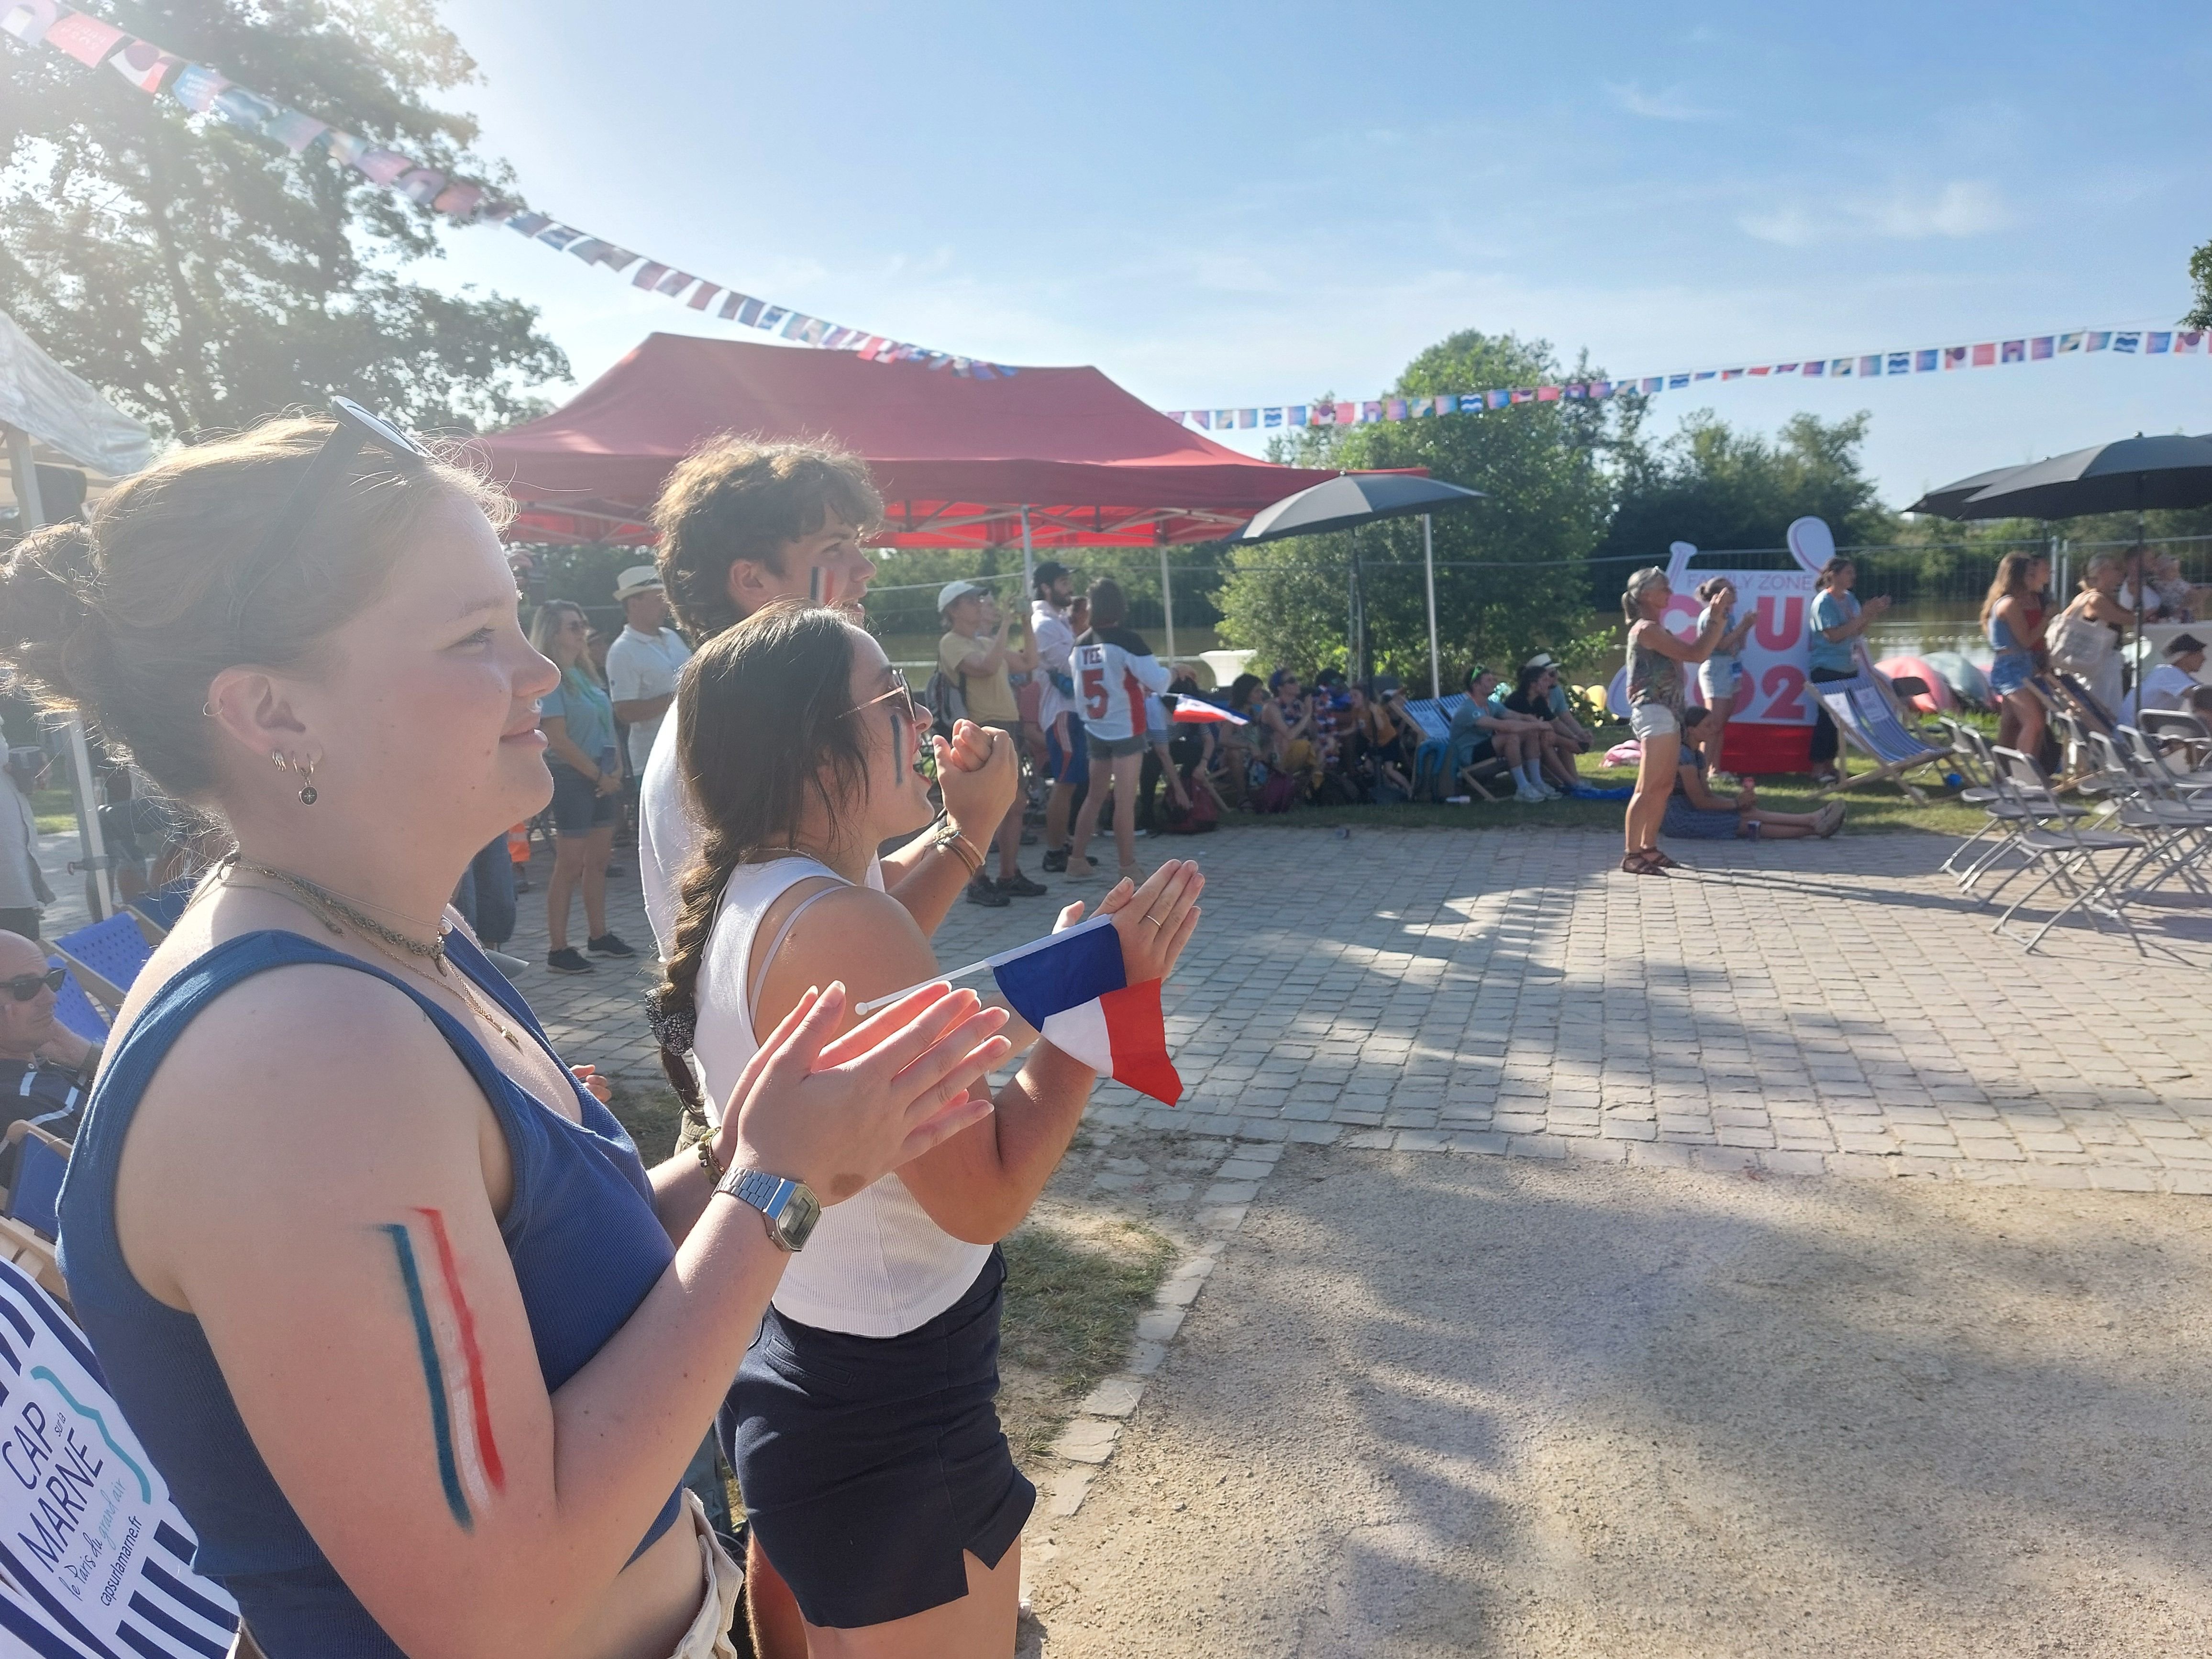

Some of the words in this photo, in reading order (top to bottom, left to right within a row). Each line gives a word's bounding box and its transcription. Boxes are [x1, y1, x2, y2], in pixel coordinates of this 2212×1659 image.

[1759, 574, 1812, 590] ZONE
[1082, 669, 1109, 719] 5
[55, 1419, 63, 1437] sur
[56, 1412, 66, 1424] la
[2, 1402, 53, 1490] CAP
[17, 1427, 104, 1573] MARNE
[113, 1478, 126, 1502] air
[99, 1489, 119, 1550] grand
[83, 1532, 103, 1558] du
[64, 1555, 96, 1584] Paris
[100, 1515, 143, 1606] capsurlamarne.fr
[58, 1576, 83, 1602] le
